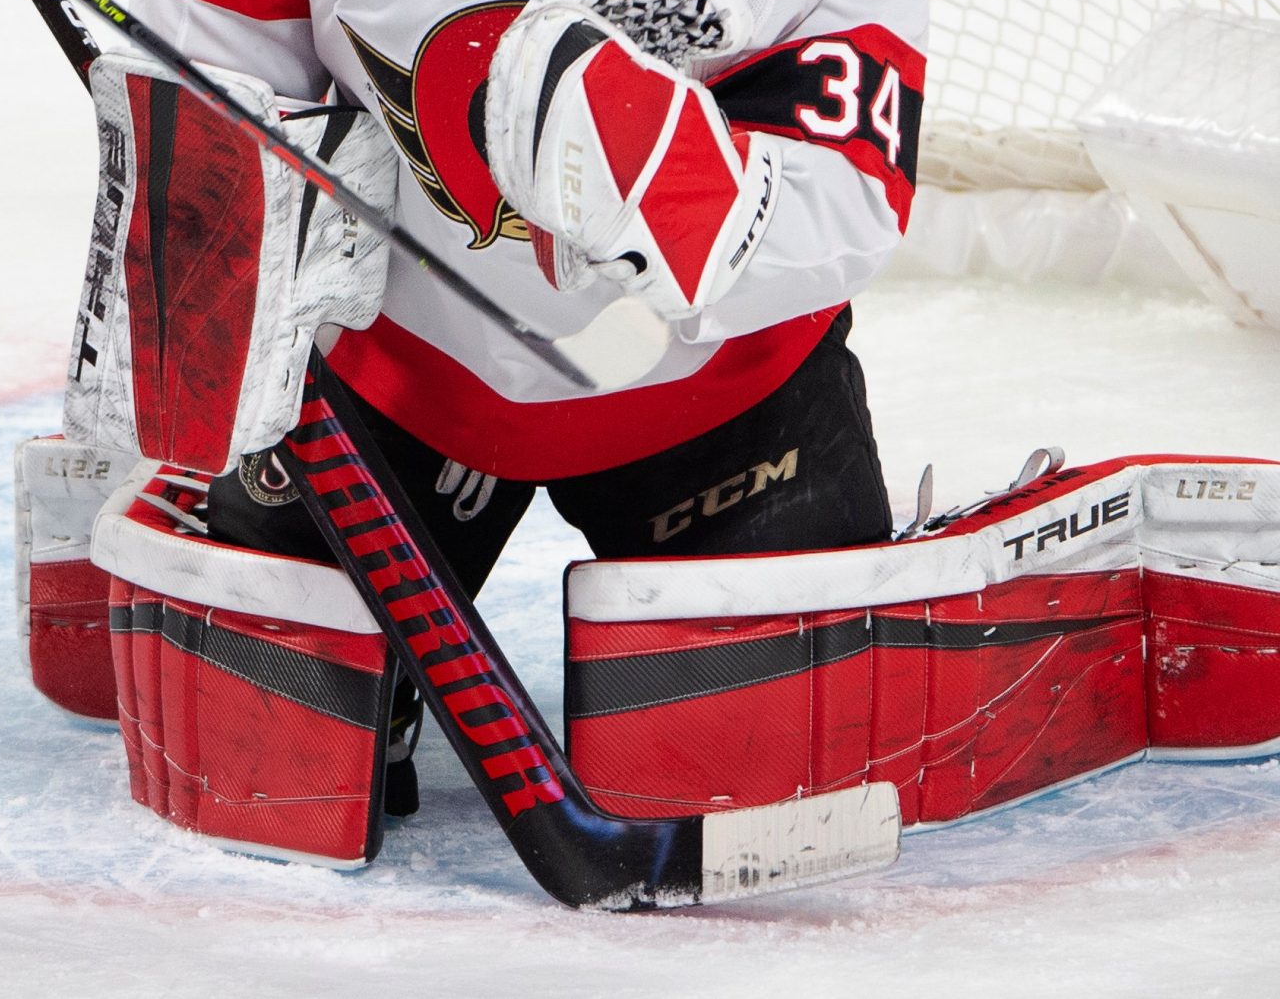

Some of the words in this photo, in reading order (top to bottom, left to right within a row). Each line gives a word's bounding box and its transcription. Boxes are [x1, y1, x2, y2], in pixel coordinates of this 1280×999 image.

[797, 38, 902, 170] 34
[563, 140, 584, 223] L12.2
[728, 150, 772, 271] TRUE
[45, 457, 111, 480] L12.2
[647, 446, 800, 544] CCM
[1175, 478, 1257, 501] L12.2
[1003, 490, 1130, 562] TRUE
